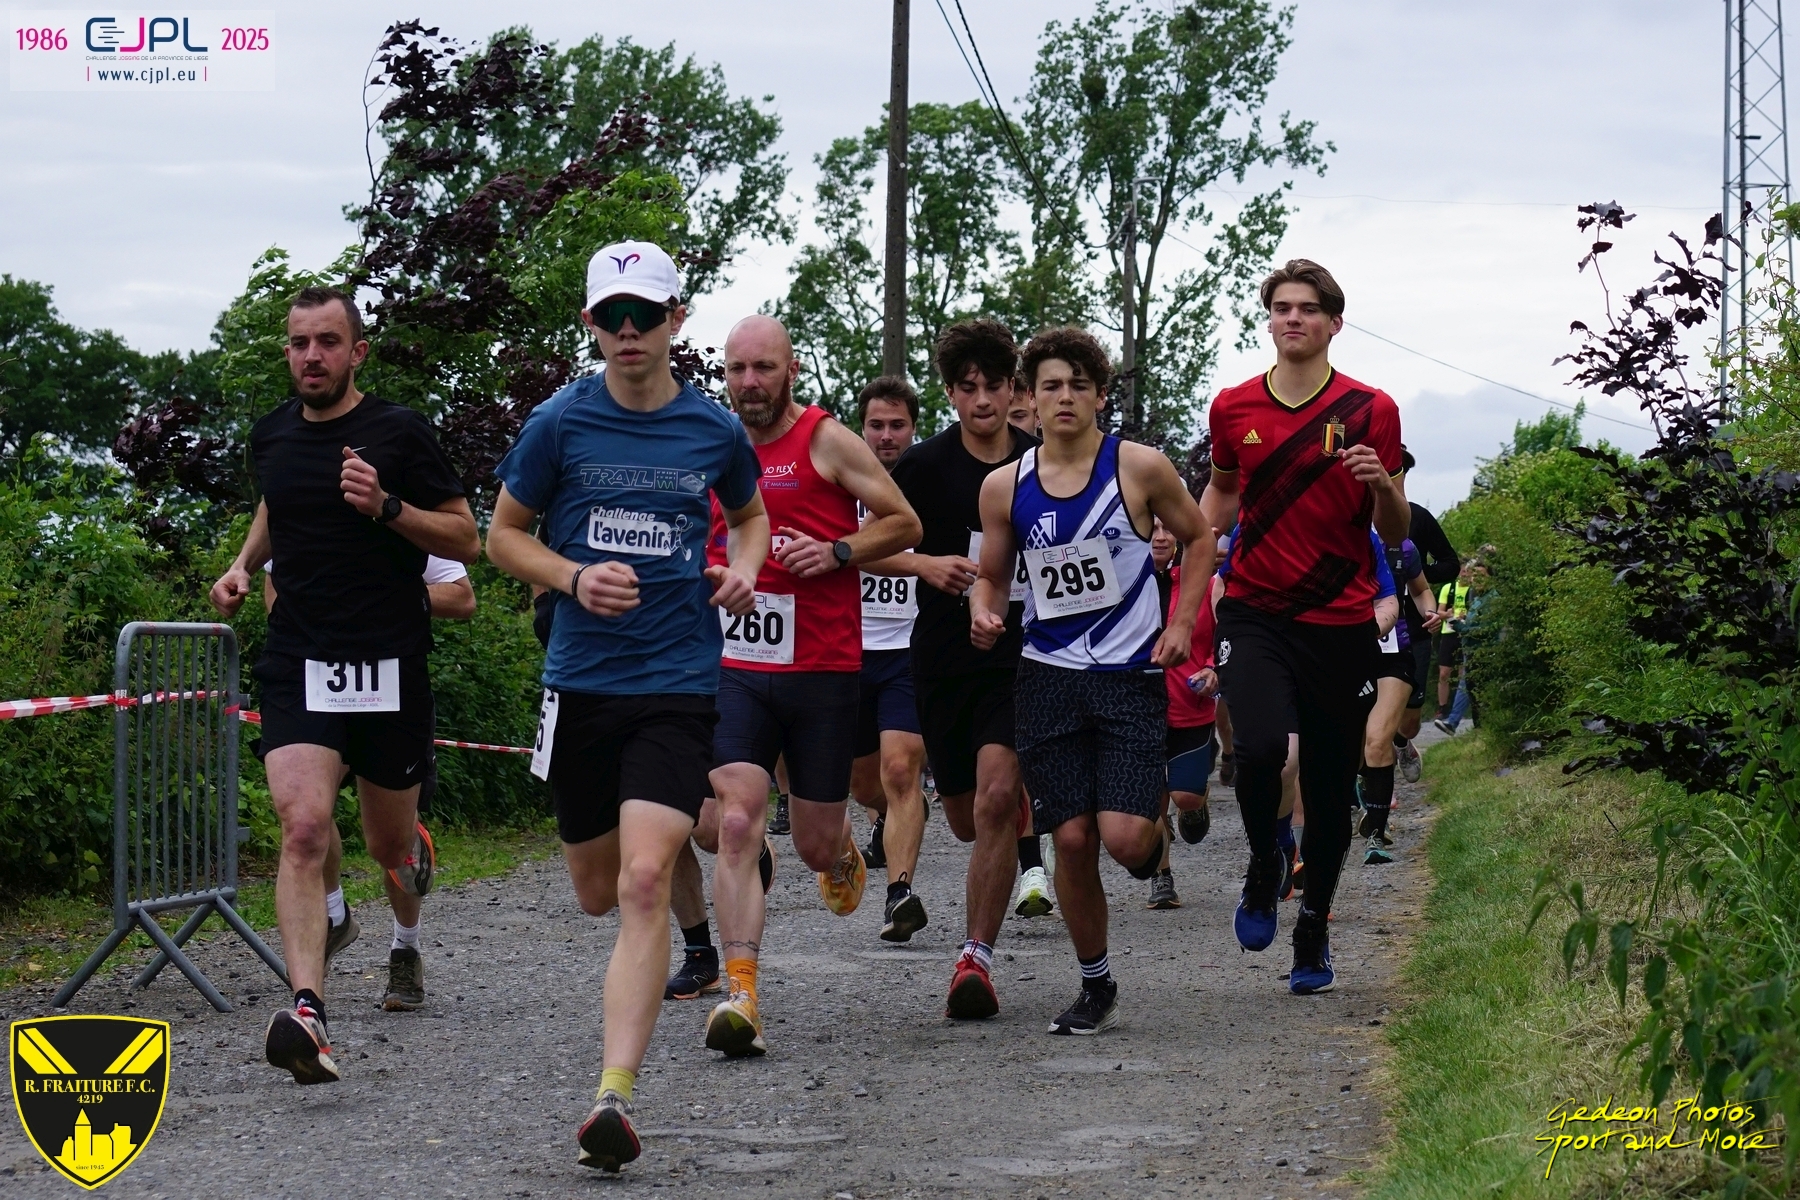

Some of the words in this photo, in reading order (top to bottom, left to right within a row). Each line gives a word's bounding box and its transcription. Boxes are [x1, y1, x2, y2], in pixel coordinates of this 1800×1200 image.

[580, 468, 654, 488] TRAIL
[590, 506, 656, 524] Challenge
[593, 520, 666, 549] l'avenir
[861, 577, 909, 605] 289
[1040, 557, 1106, 600] 295
[1053, 599, 1082, 609] CHALLENGE
[725, 609, 784, 646] 260
[327, 660, 380, 692] 311
